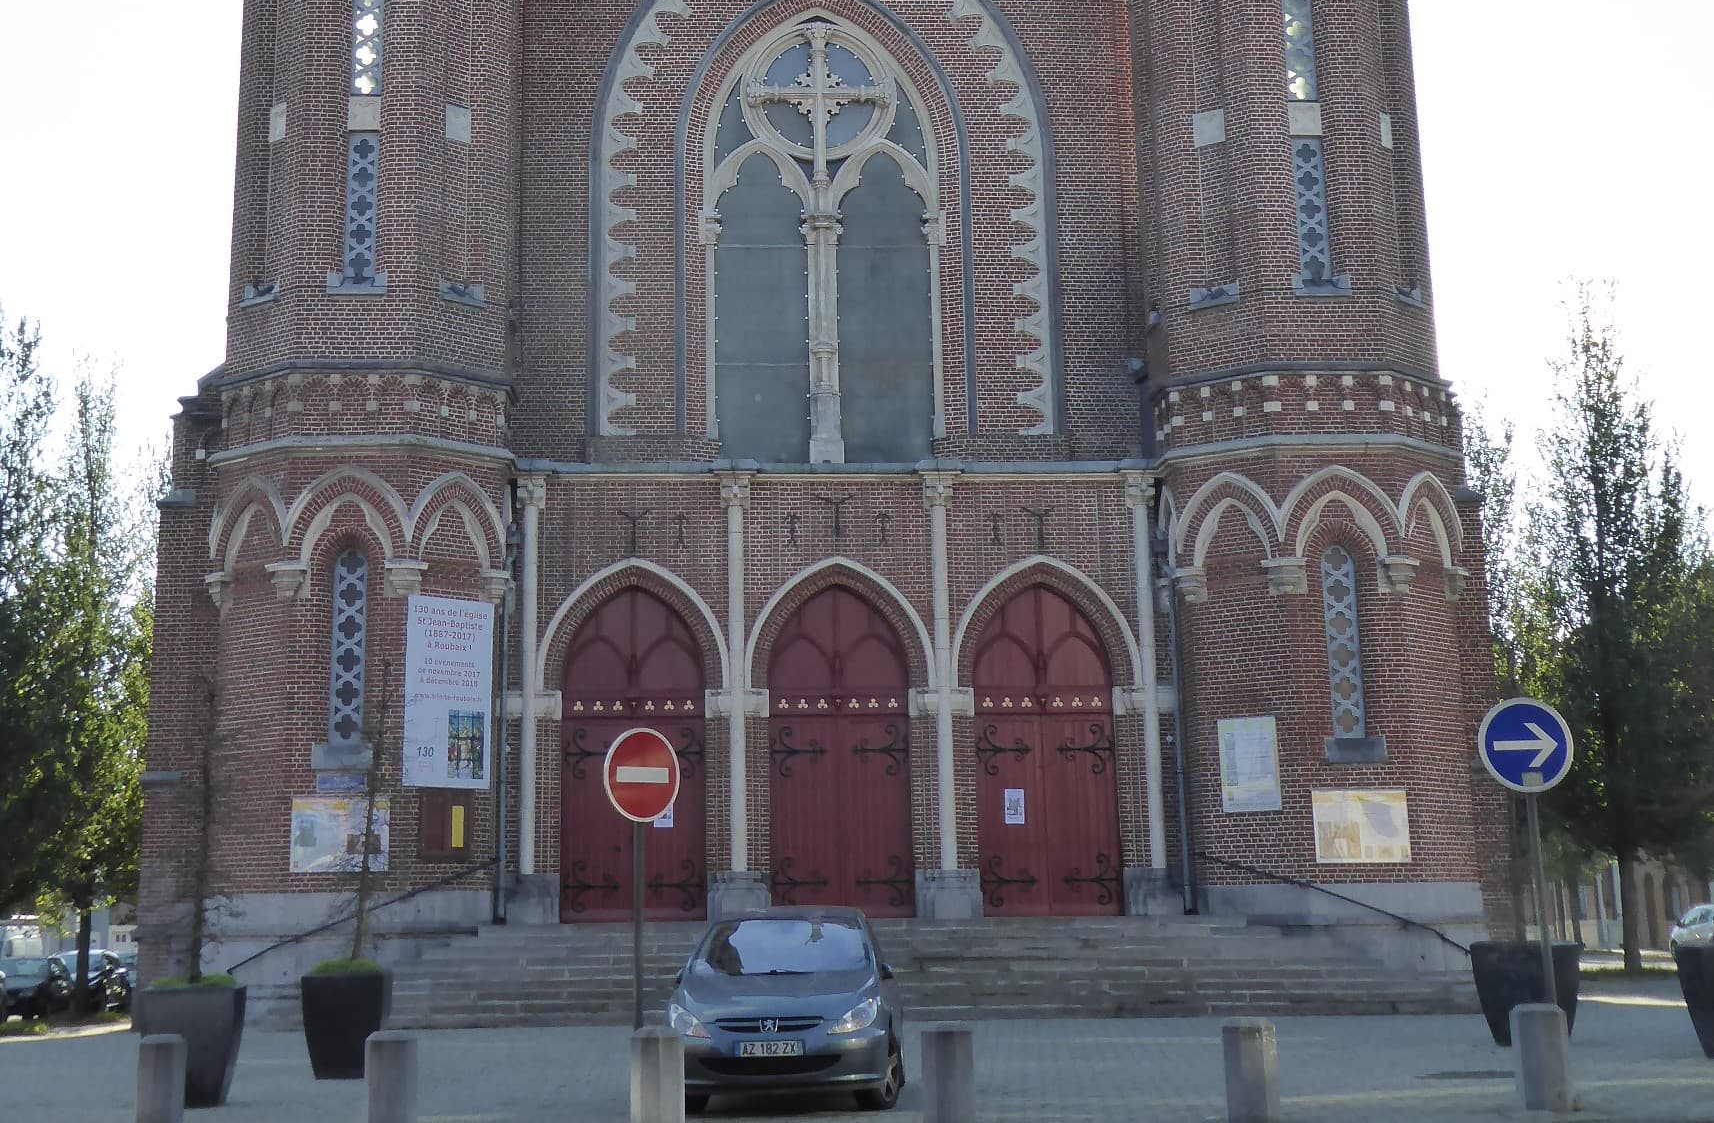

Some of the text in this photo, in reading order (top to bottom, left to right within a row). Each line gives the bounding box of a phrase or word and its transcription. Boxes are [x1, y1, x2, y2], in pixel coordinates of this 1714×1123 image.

[414, 605, 429, 614] 130
[431, 608, 446, 616] ans
[447, 609, 458, 617] de
[417, 617, 483, 631] St Jean-Baptiste
[424, 629, 476, 643] (1887-2017)
[434, 641, 467, 651] Roubaix
[424, 657, 433, 665] 10
[463, 670, 480, 678] 2017
[462, 679, 479, 688] 2018
[417, 746, 434, 757] 130
[742, 1042, 796, 1056] AZ 182 ZX
